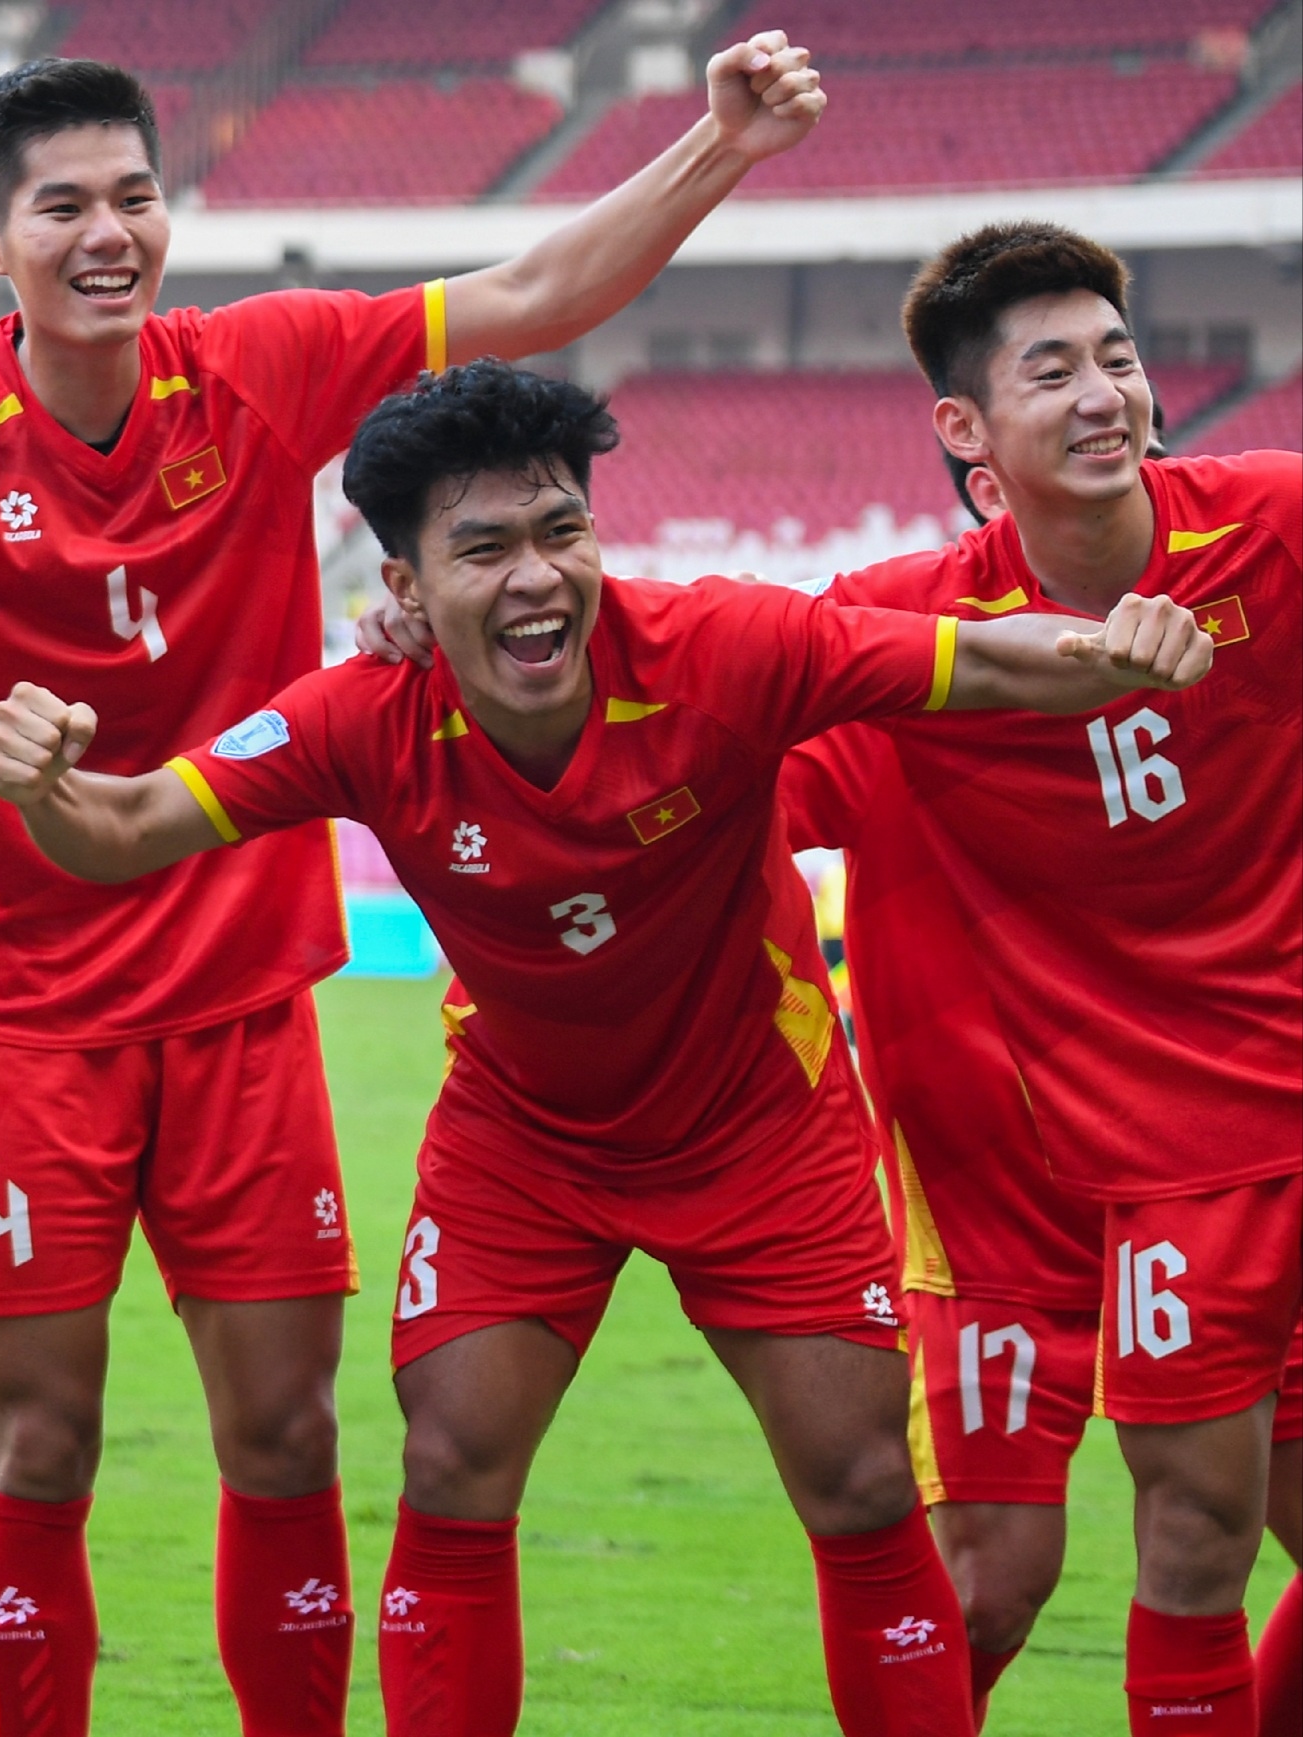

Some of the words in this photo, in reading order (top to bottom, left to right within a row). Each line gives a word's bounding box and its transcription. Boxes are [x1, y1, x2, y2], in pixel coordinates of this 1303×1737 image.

[107, 565, 167, 662] 4
[1087, 707, 1186, 827] 16
[551, 893, 616, 954] 3
[400, 1215, 440, 1320] 3
[1118, 1240, 1191, 1359] 16
[959, 1322, 1035, 1434] 17
